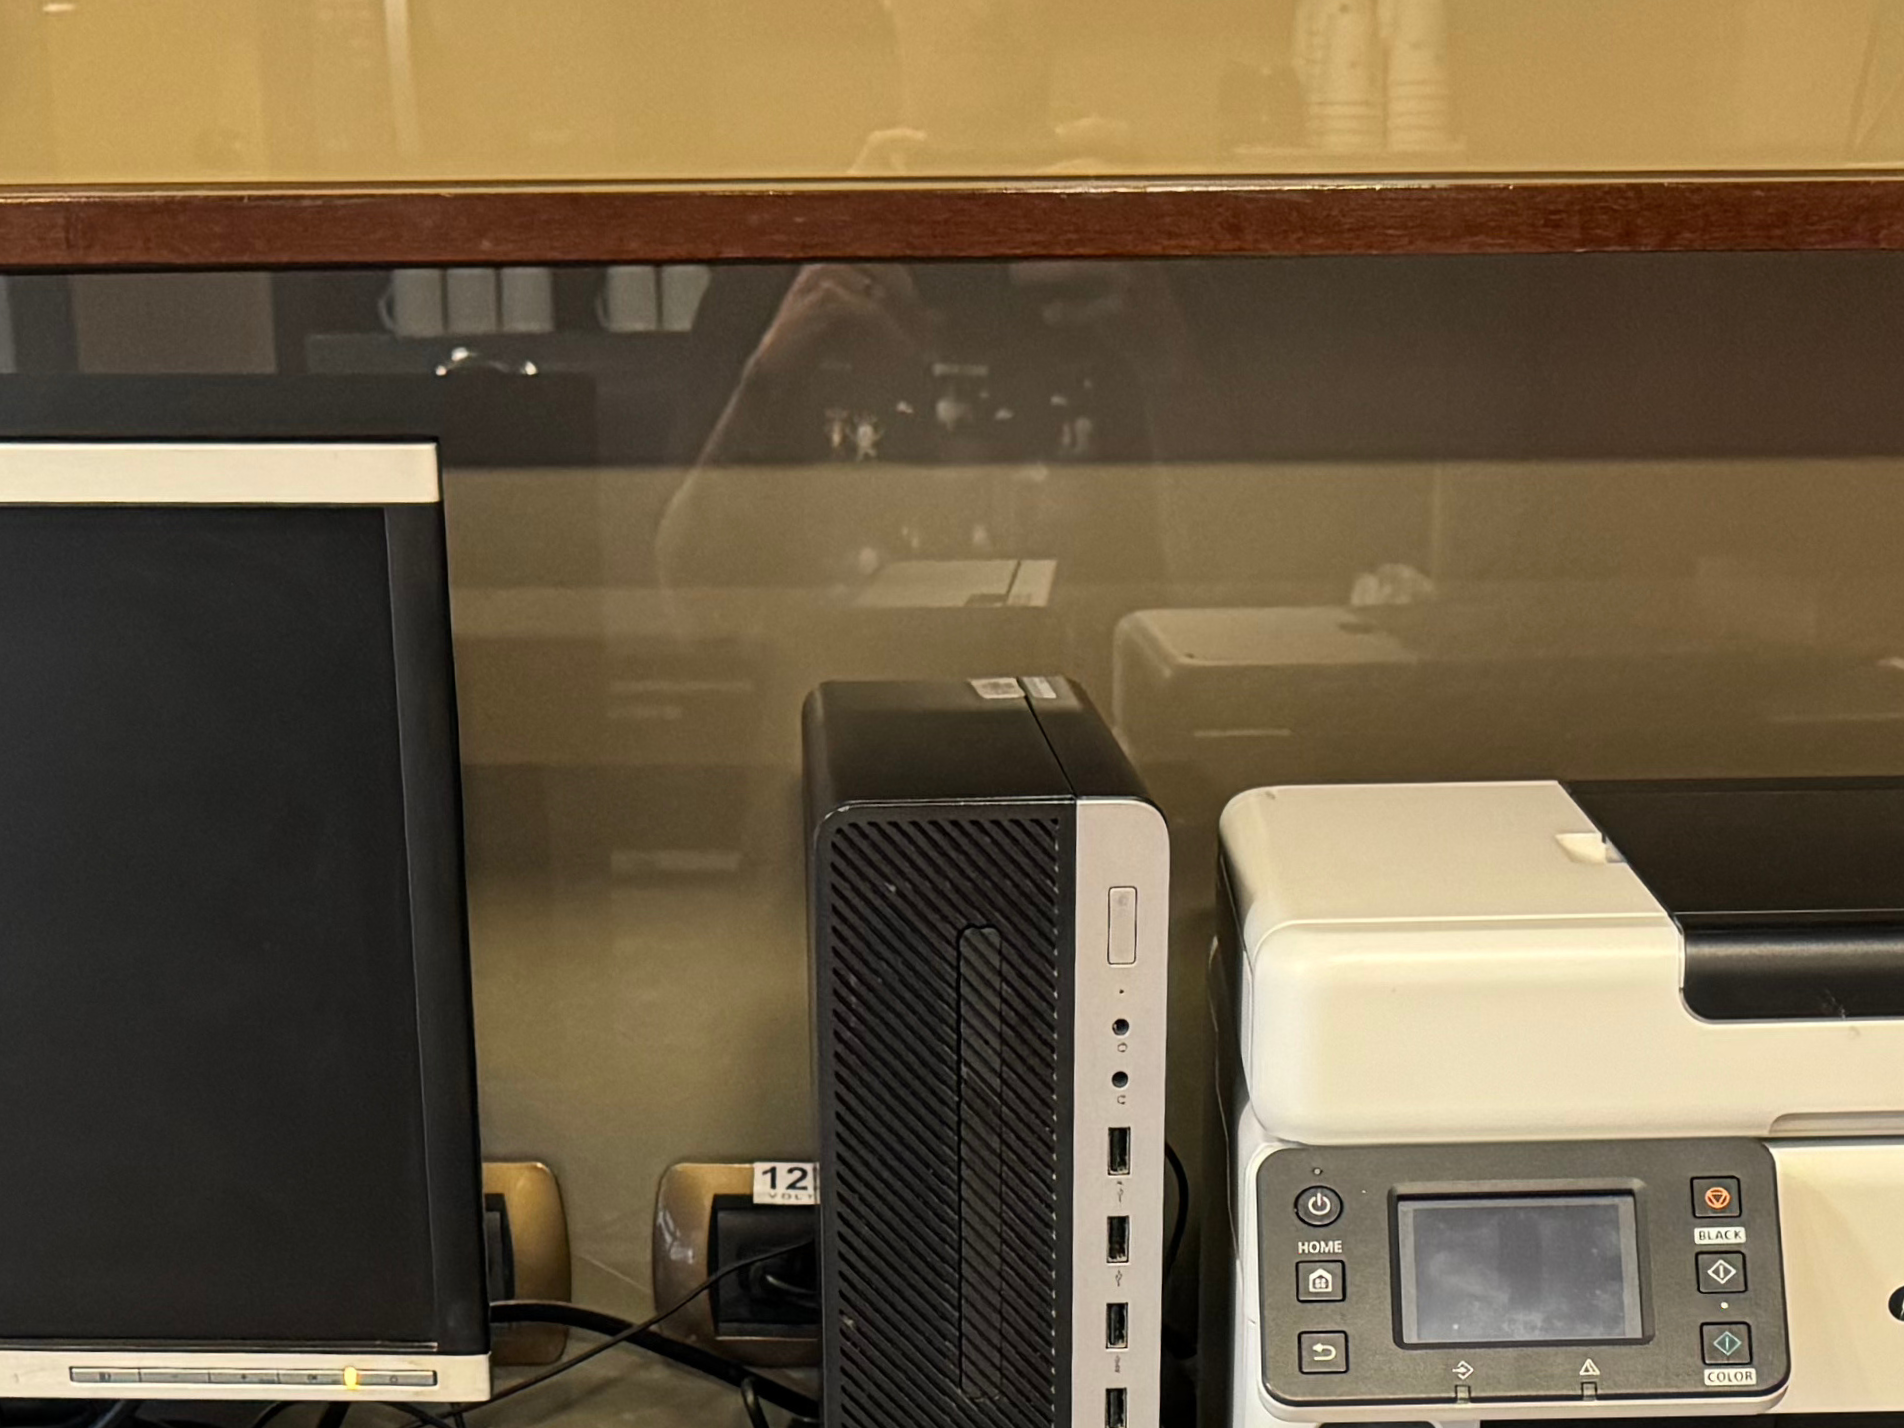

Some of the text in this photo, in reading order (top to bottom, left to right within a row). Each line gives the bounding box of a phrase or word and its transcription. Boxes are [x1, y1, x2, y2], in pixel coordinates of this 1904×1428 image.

[1698, 1230, 1743, 1241] BLACK
[1297, 1240, 1343, 1254] HOME
[1707, 1370, 1753, 1383] COLOR
